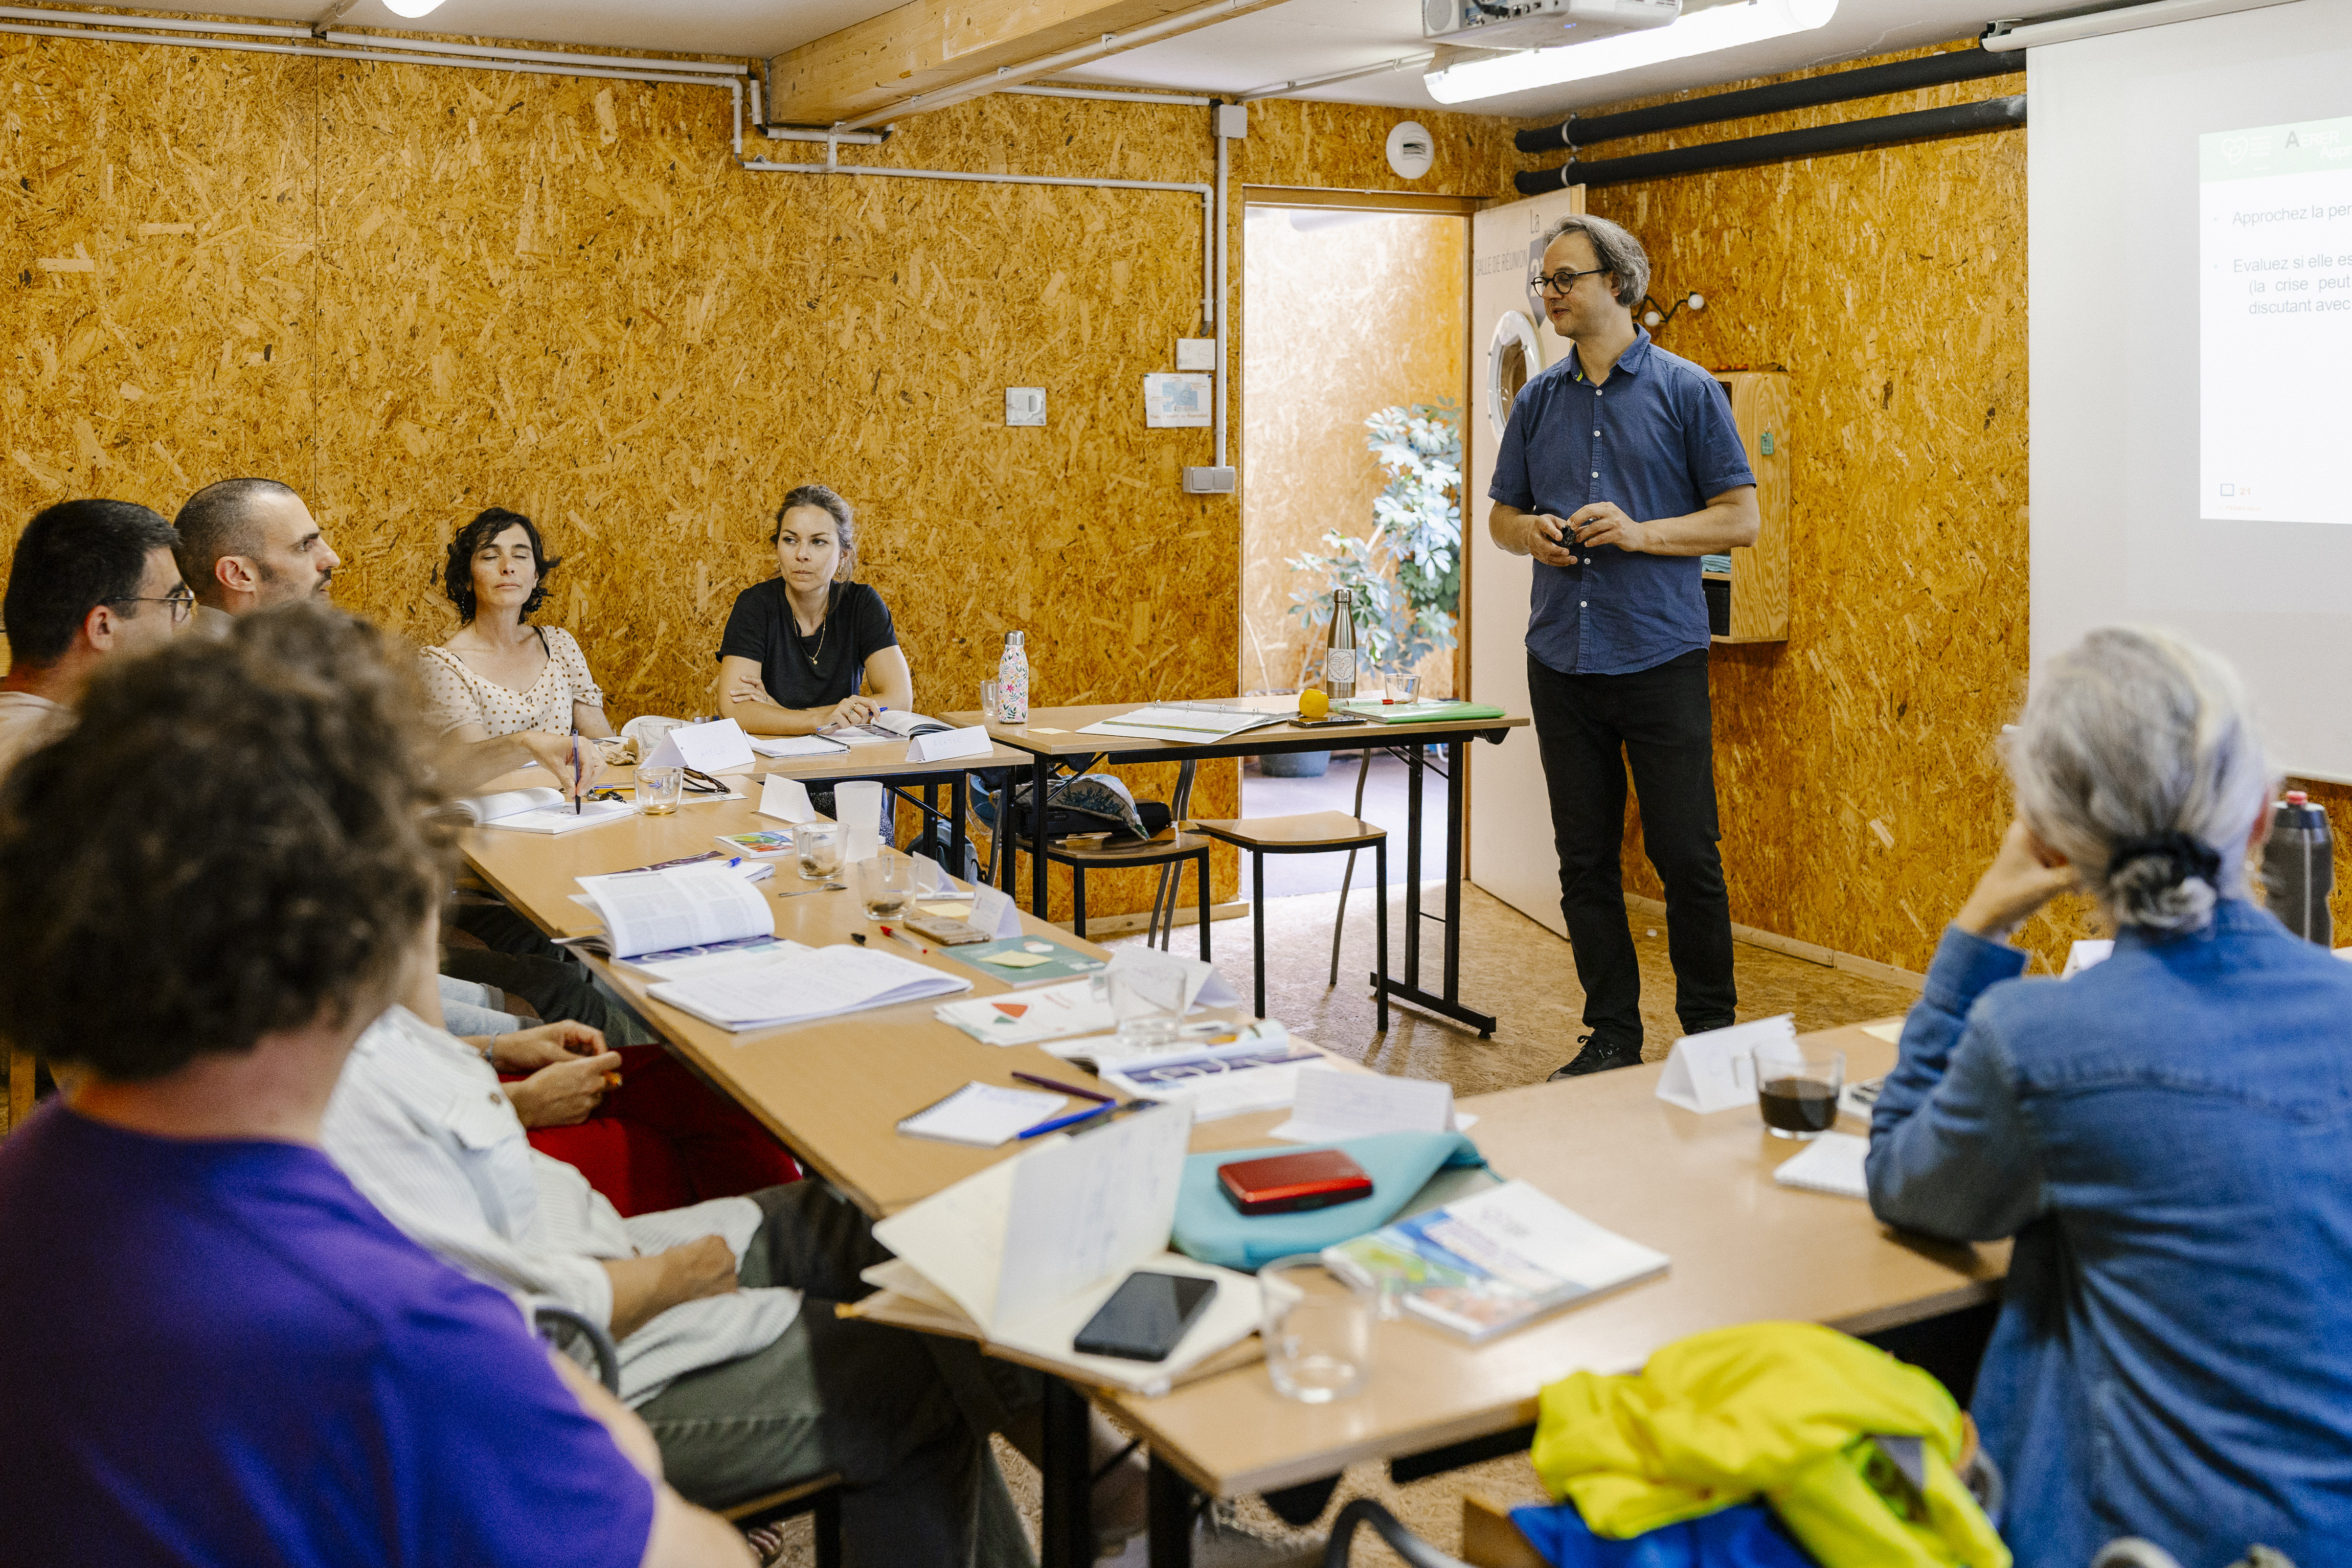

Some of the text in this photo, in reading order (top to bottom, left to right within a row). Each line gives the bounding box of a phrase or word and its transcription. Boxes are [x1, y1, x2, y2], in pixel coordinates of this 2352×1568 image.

[1530, 209, 1540, 234] La
[2232, 204, 2352, 228] Approchez la per
[1476, 249, 1528, 277] SALLE DE RÉUNION
[2233, 254, 2352, 273] Evaluez si elle es
[2249, 275, 2350, 297] (la crise peut
[2249, 299, 2350, 314] discutant avec
[2240, 487, 2251, 495] 21
